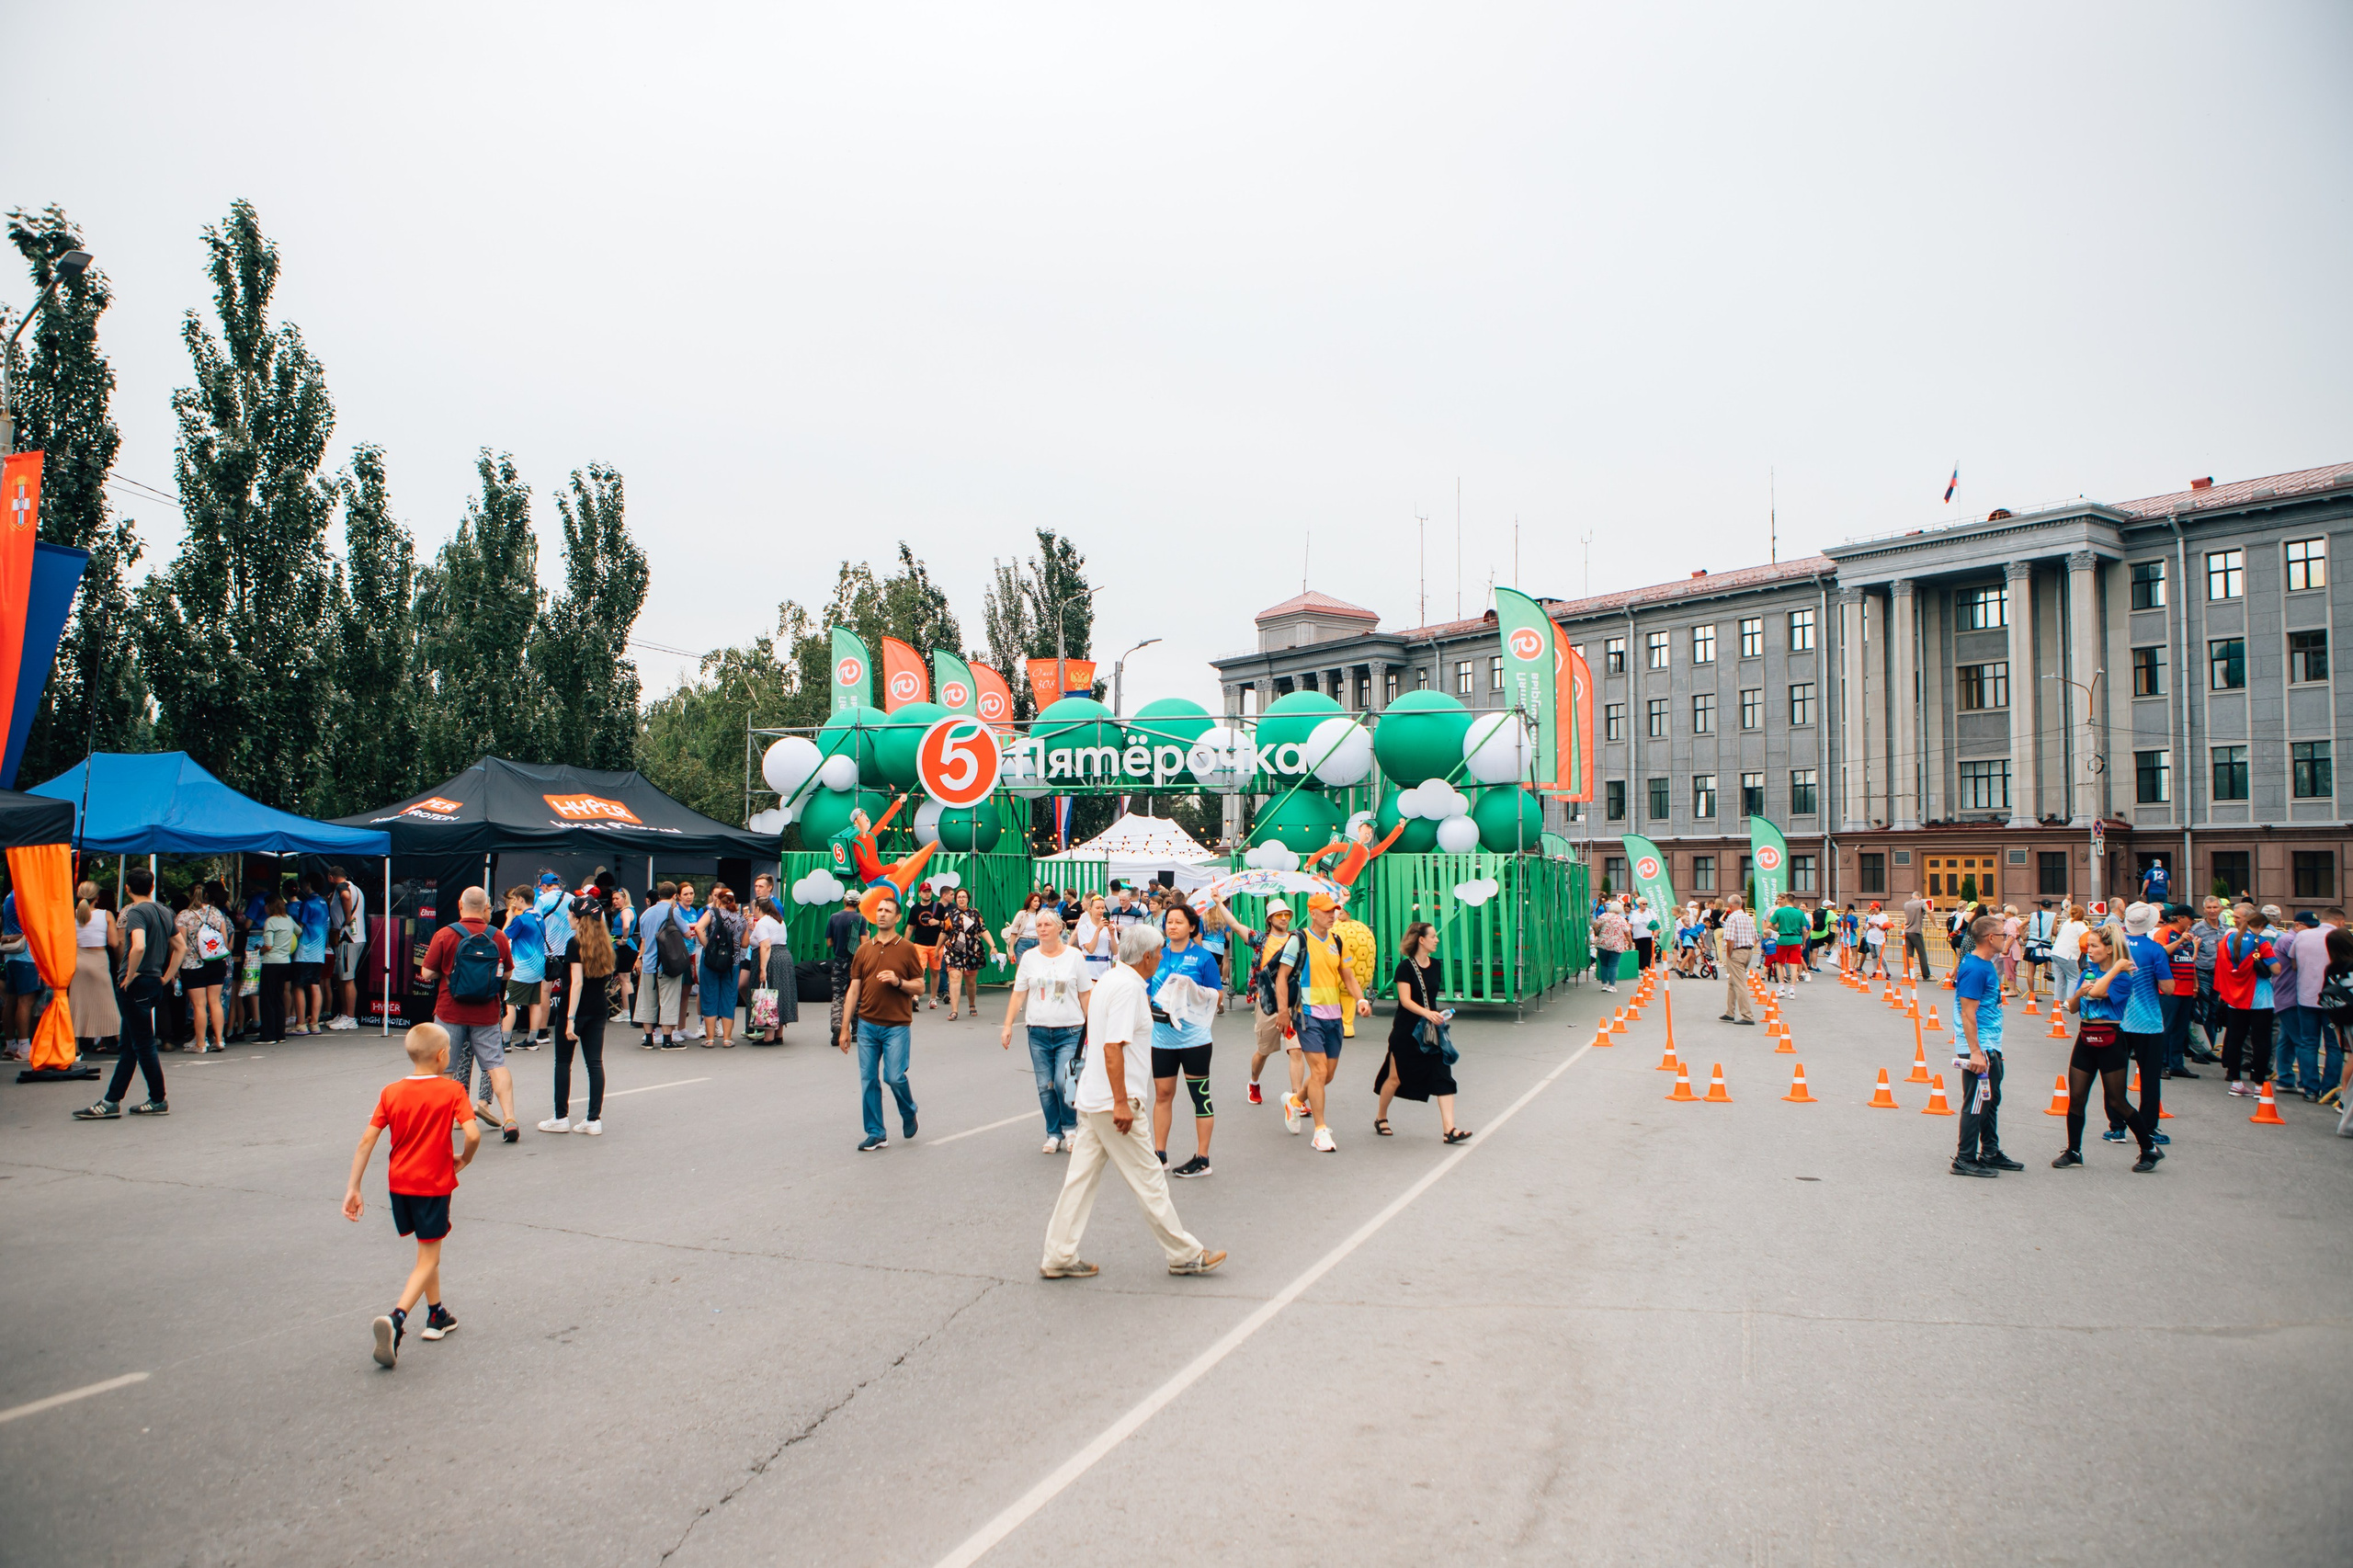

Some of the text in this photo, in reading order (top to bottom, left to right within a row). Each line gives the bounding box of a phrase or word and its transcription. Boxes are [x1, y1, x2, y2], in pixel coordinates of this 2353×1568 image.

[1015, 734, 1307, 789] Пятёрочка
[551, 798, 634, 820] HYPER
[2153, 870, 2165, 881] 12
[372, 1002, 401, 1012] HYER
[360, 1016, 381, 1024] HIGH
